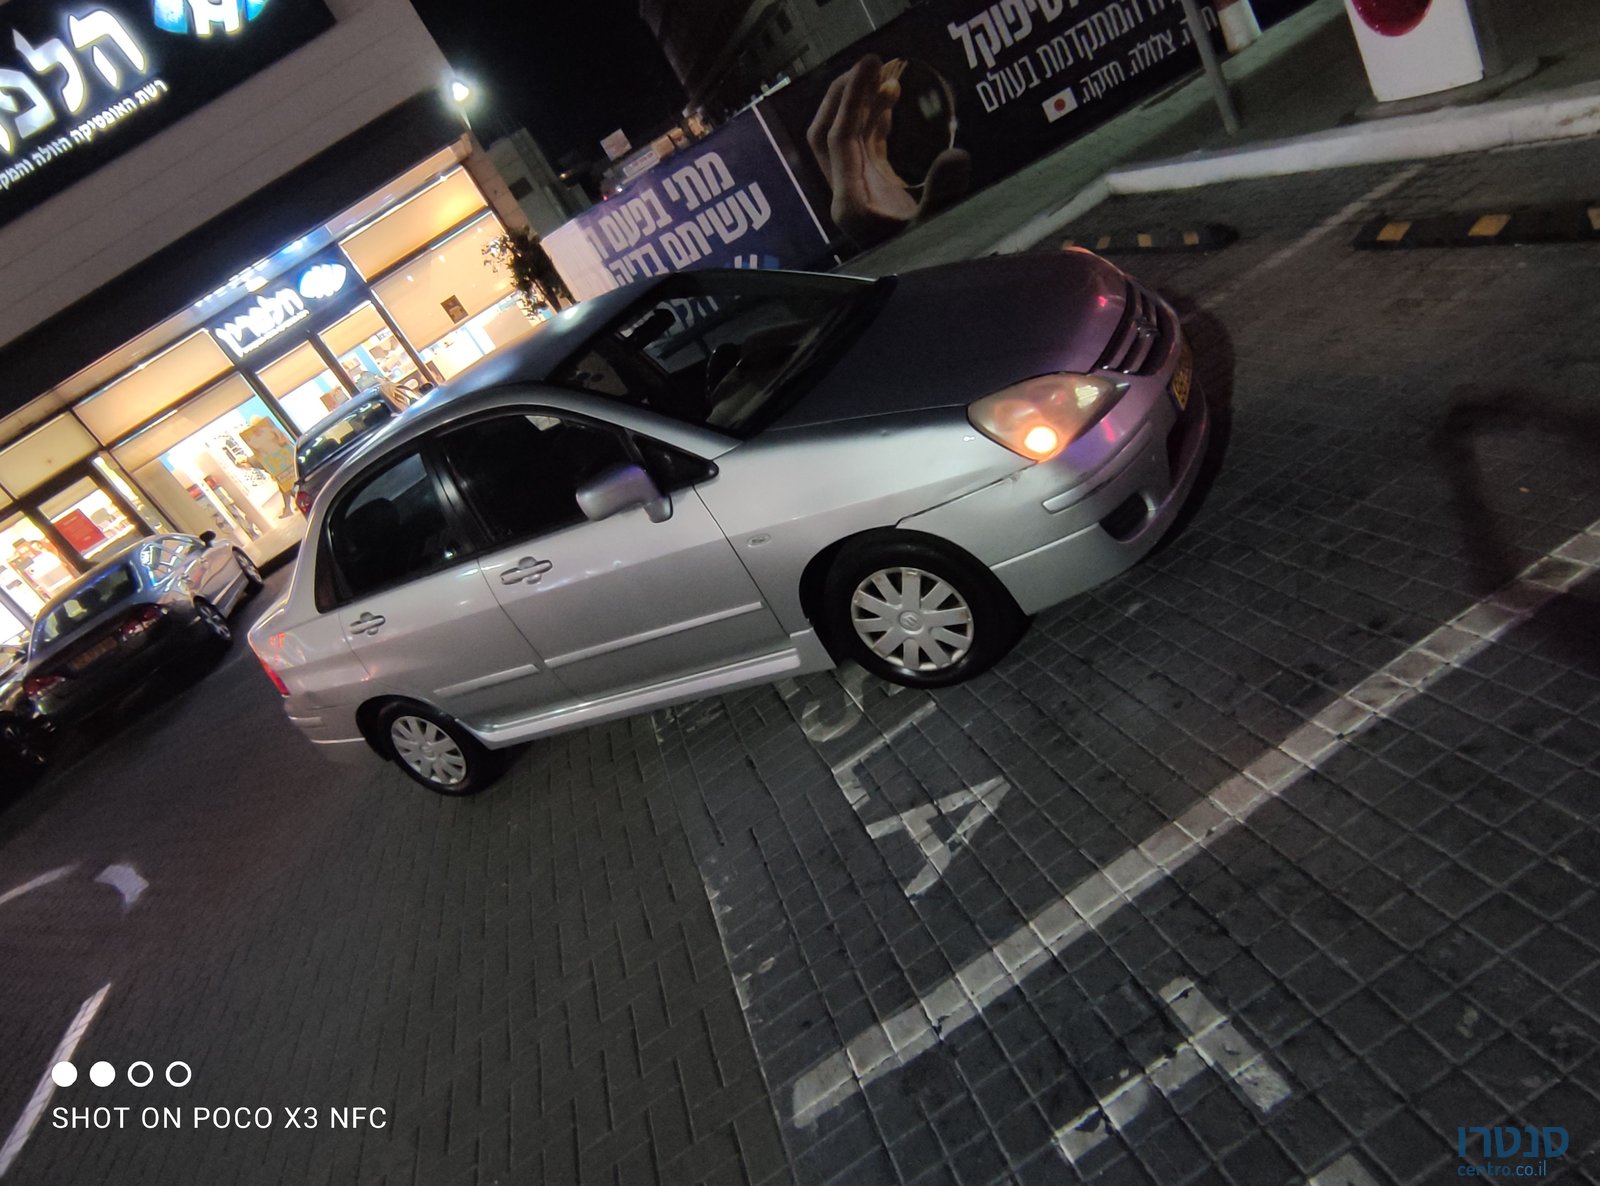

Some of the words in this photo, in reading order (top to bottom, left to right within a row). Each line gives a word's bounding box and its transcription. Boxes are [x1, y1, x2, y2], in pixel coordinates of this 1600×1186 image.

[1127, 28, 1178, 77] צלולה.
[0, 9, 147, 154] הלפ
[133, 79, 170, 106] רשת
[975, 55, 1041, 114] בעולם
[1079, 60, 1126, 105] חזקה.
[69, 97, 138, 142] האופטיקה
[0, 156, 36, 191] והמק
[33, 132, 73, 166] הזולה
[661, 151, 736, 212] מתי
[597, 187, 674, 253] בפעם
[658, 181, 772, 271] עשיתם
